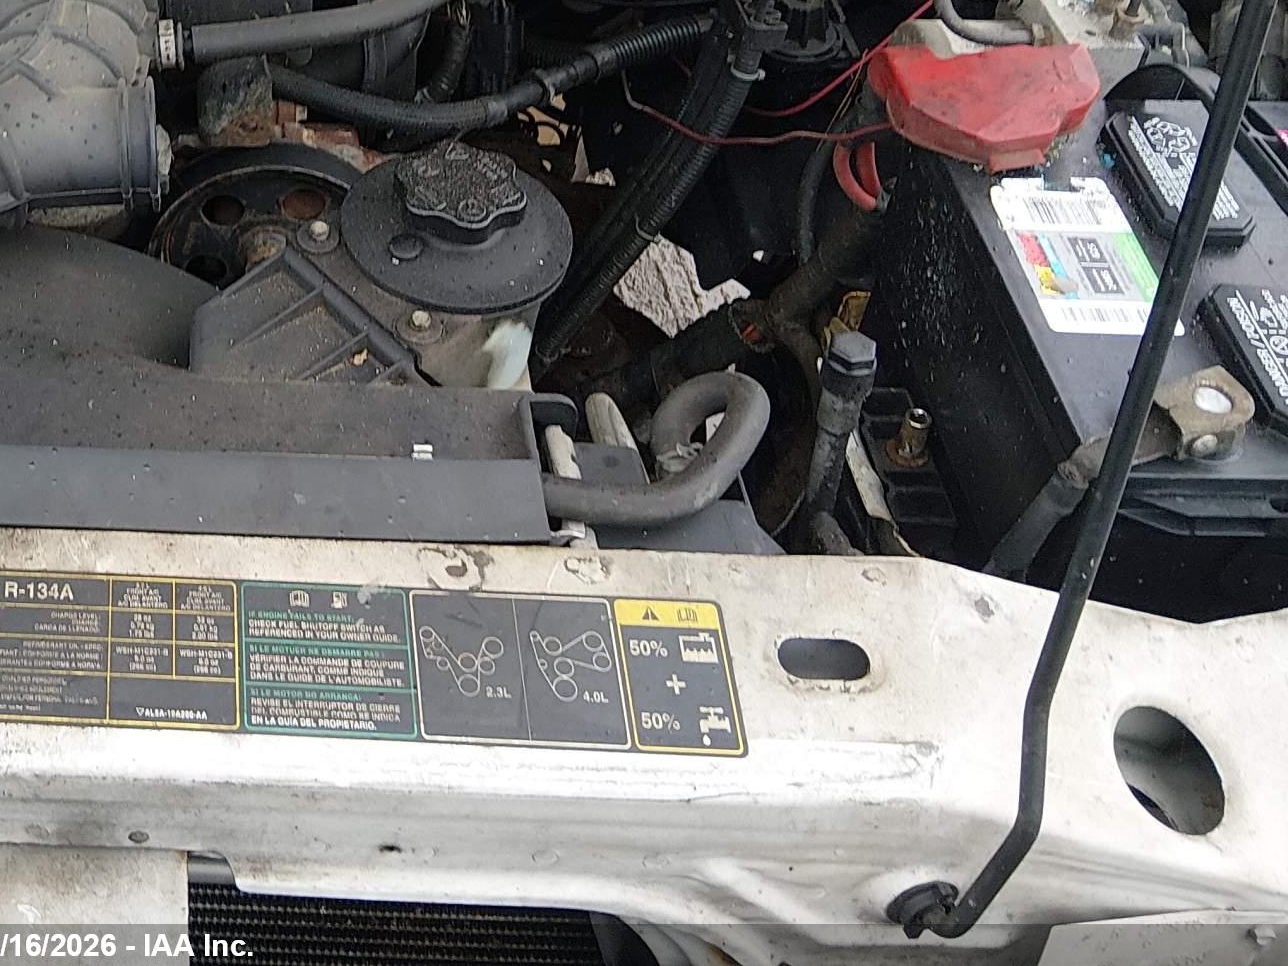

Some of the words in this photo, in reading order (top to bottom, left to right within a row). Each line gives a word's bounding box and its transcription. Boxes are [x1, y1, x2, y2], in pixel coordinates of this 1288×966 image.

[4, 581, 74, 601] R-134A
[248, 619, 277, 629] CHECK
[279, 621, 298, 629] FUEL
[301, 622, 338, 632] SHUTOFF
[341, 623, 372, 632] SWITCH
[374, 625, 385, 633] AS
[248, 628, 303, 638] REFERENCED
[314, 630, 338, 639] YOUR
[341, 632, 370, 641] OWNER
[629, 639, 669, 658] 50%
[250, 662, 260, 671] DE
[318, 666, 348, 674] COMME
[289, 655, 299, 664] LA
[301, 657, 349, 666] COMMANDE
[351, 658, 362, 667] DE
[364, 659, 405, 670] COUPURE
[250, 671, 273, 680] DANS
[275, 673, 286, 681] LE
[288, 673, 312, 682] GUIDE
[315, 675, 327, 683] DE
[486, 686, 512, 699] 2.3L
[583, 691, 609, 704] 4.0L
[251, 697, 281, 707] REVISE
[283, 698, 293, 707] EL
[295, 699, 354, 710] INTERRUPTOR
[356, 702, 367, 711] DE
[369, 703, 400, 713] CIERRE
[252, 706, 267, 715] DEL
[270, 707, 330, 718] COMBUSTIBLE
[331, 710, 357, 719] COMO
[359, 712, 369, 720] SE
[372, 712, 400, 722] INDICA
[641, 711, 681, 732] 50%
[252, 715, 263, 725] EN
[265, 716, 276, 725] LA
[300, 718, 316, 727] DEL
[318, 719, 377, 730] PROPIETARIO.
